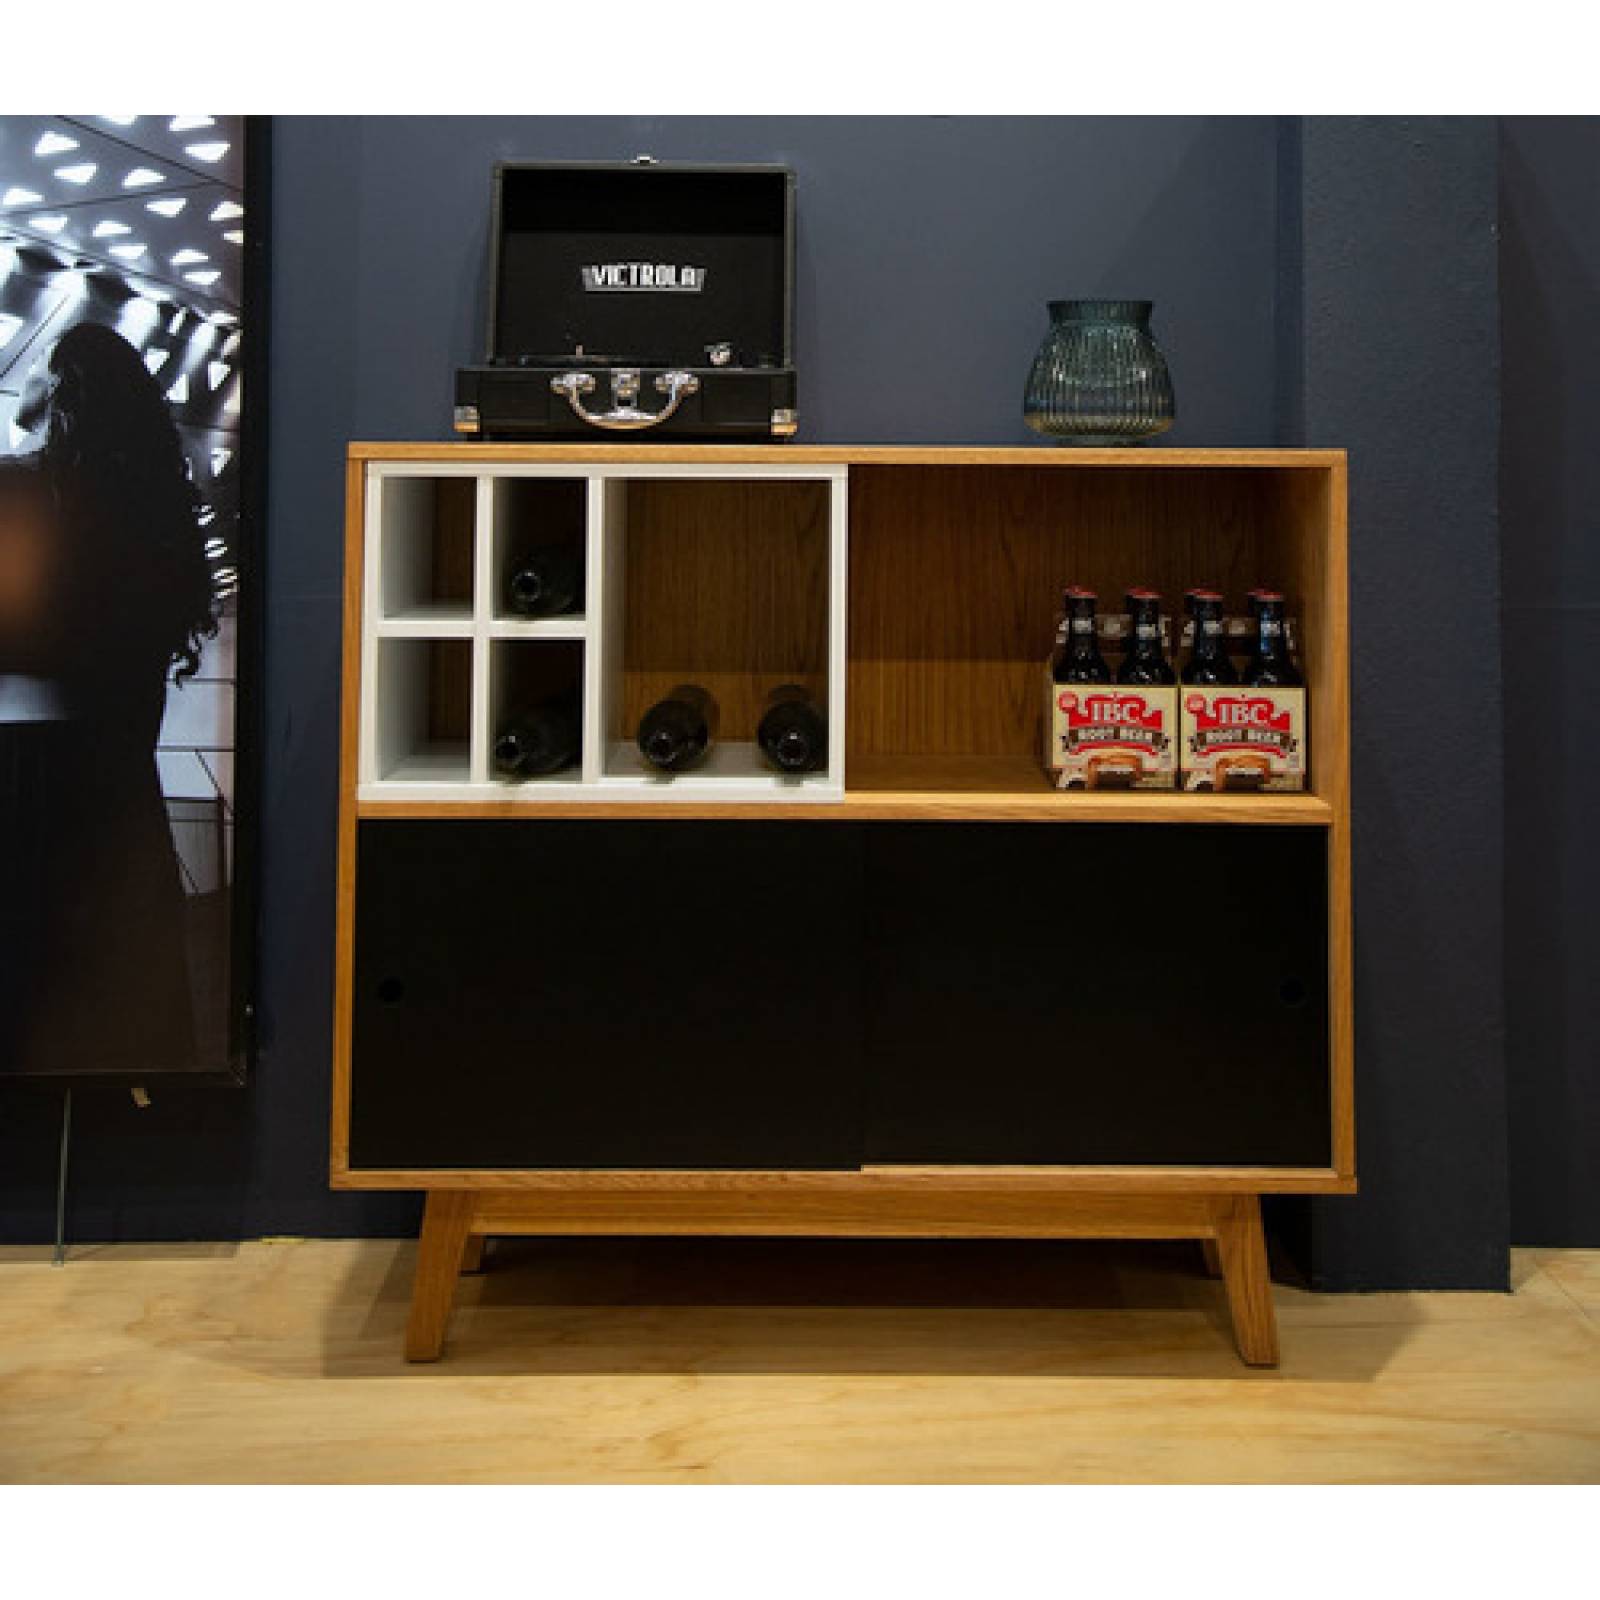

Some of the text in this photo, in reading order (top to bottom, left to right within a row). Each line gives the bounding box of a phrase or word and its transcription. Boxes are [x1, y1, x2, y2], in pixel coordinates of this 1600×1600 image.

[591, 264, 695, 286] VICTROLA
[1091, 701, 1142, 724] IBC
[1219, 703, 1269, 725] IBC
